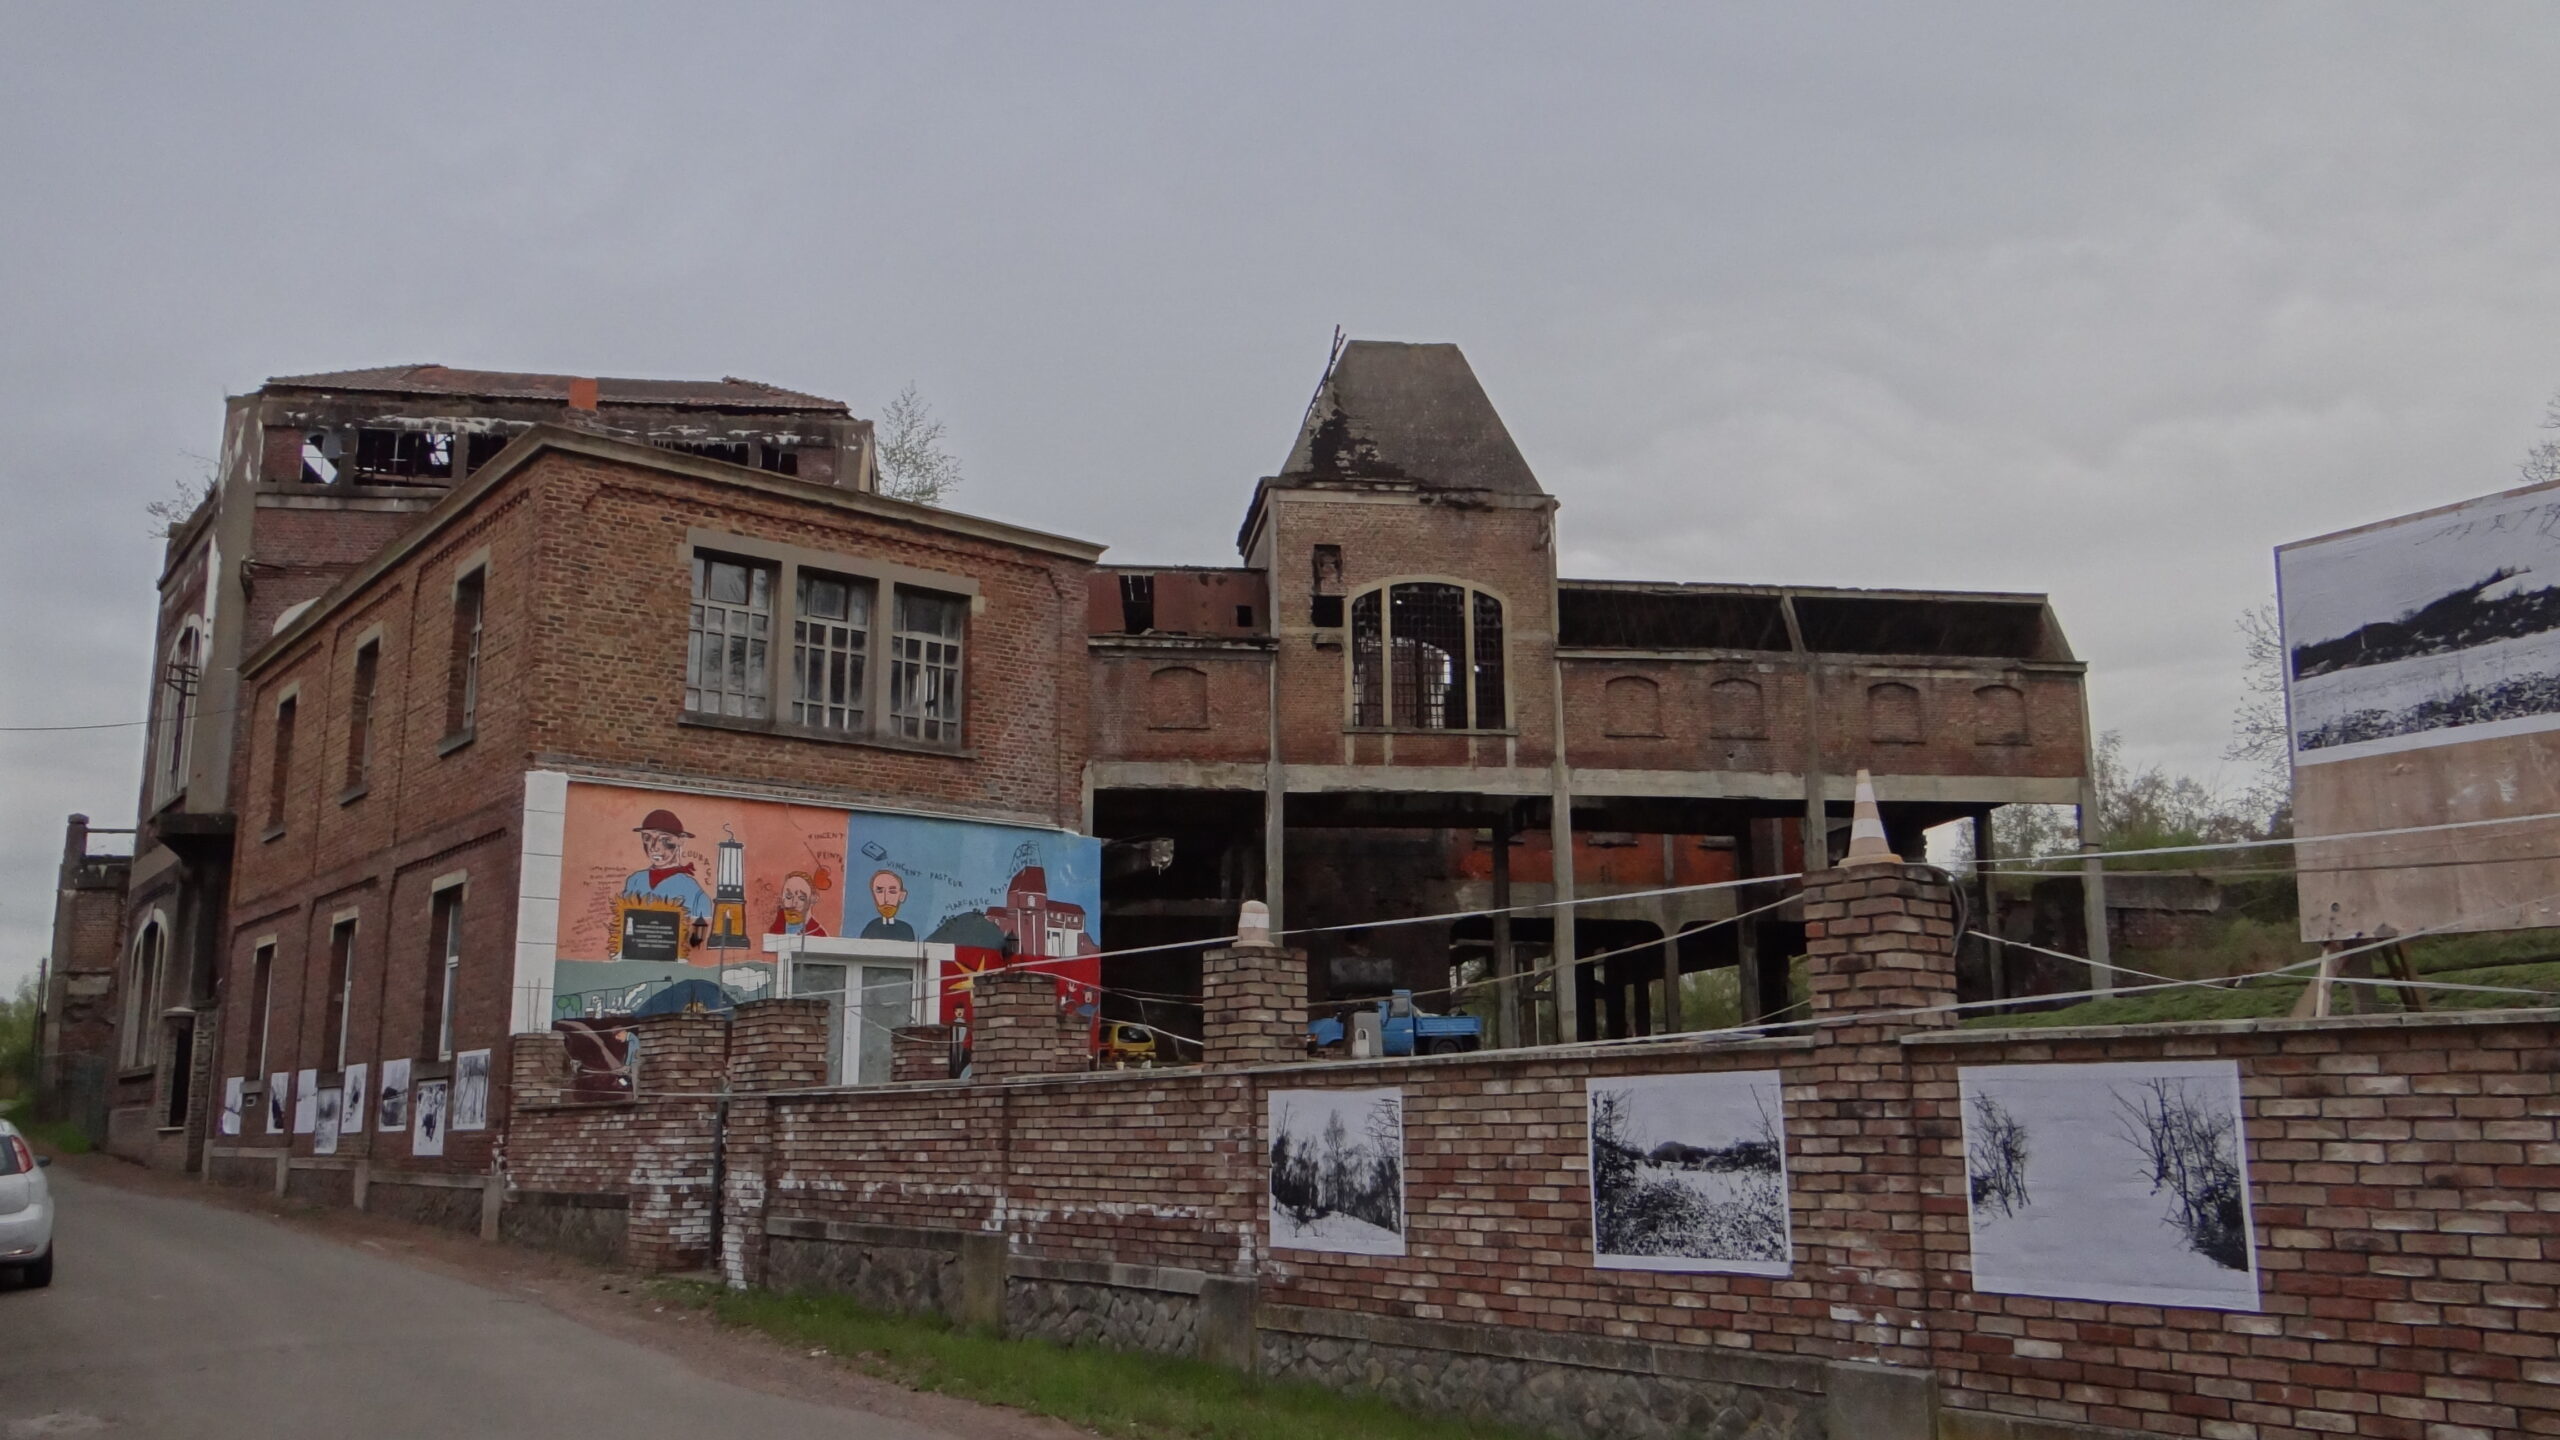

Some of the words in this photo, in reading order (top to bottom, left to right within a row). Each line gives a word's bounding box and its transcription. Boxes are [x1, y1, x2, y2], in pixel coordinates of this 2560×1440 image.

[681, 849, 711, 886] COURAGE
[886, 860, 921, 877] VINCENT
[929, 871, 964, 889] PASTEUR
